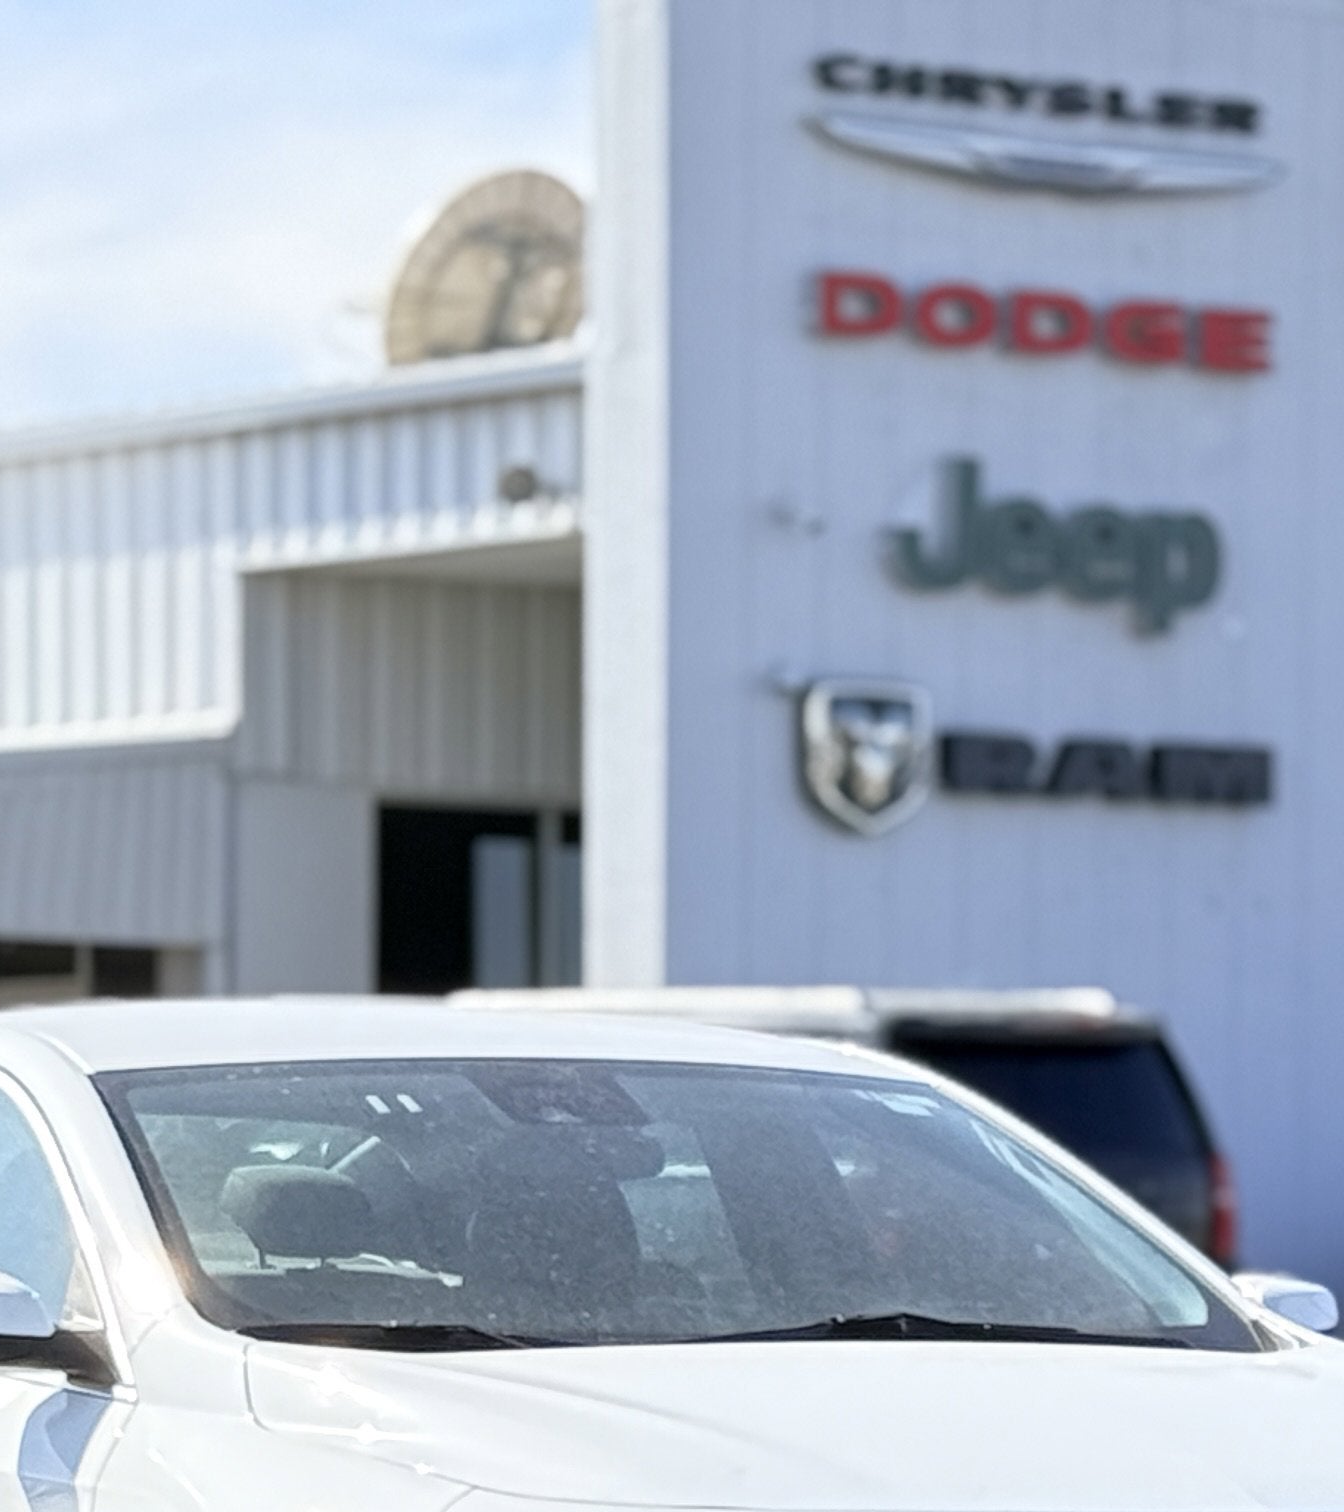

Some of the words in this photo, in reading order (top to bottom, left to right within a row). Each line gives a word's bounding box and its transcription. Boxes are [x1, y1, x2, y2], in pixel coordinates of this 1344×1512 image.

[814, 55, 1262, 134] CHRYSLER
[818, 270, 1275, 375] DODGE
[885, 456, 1223, 640] Jeep
[937, 732, 1275, 810] RAM
